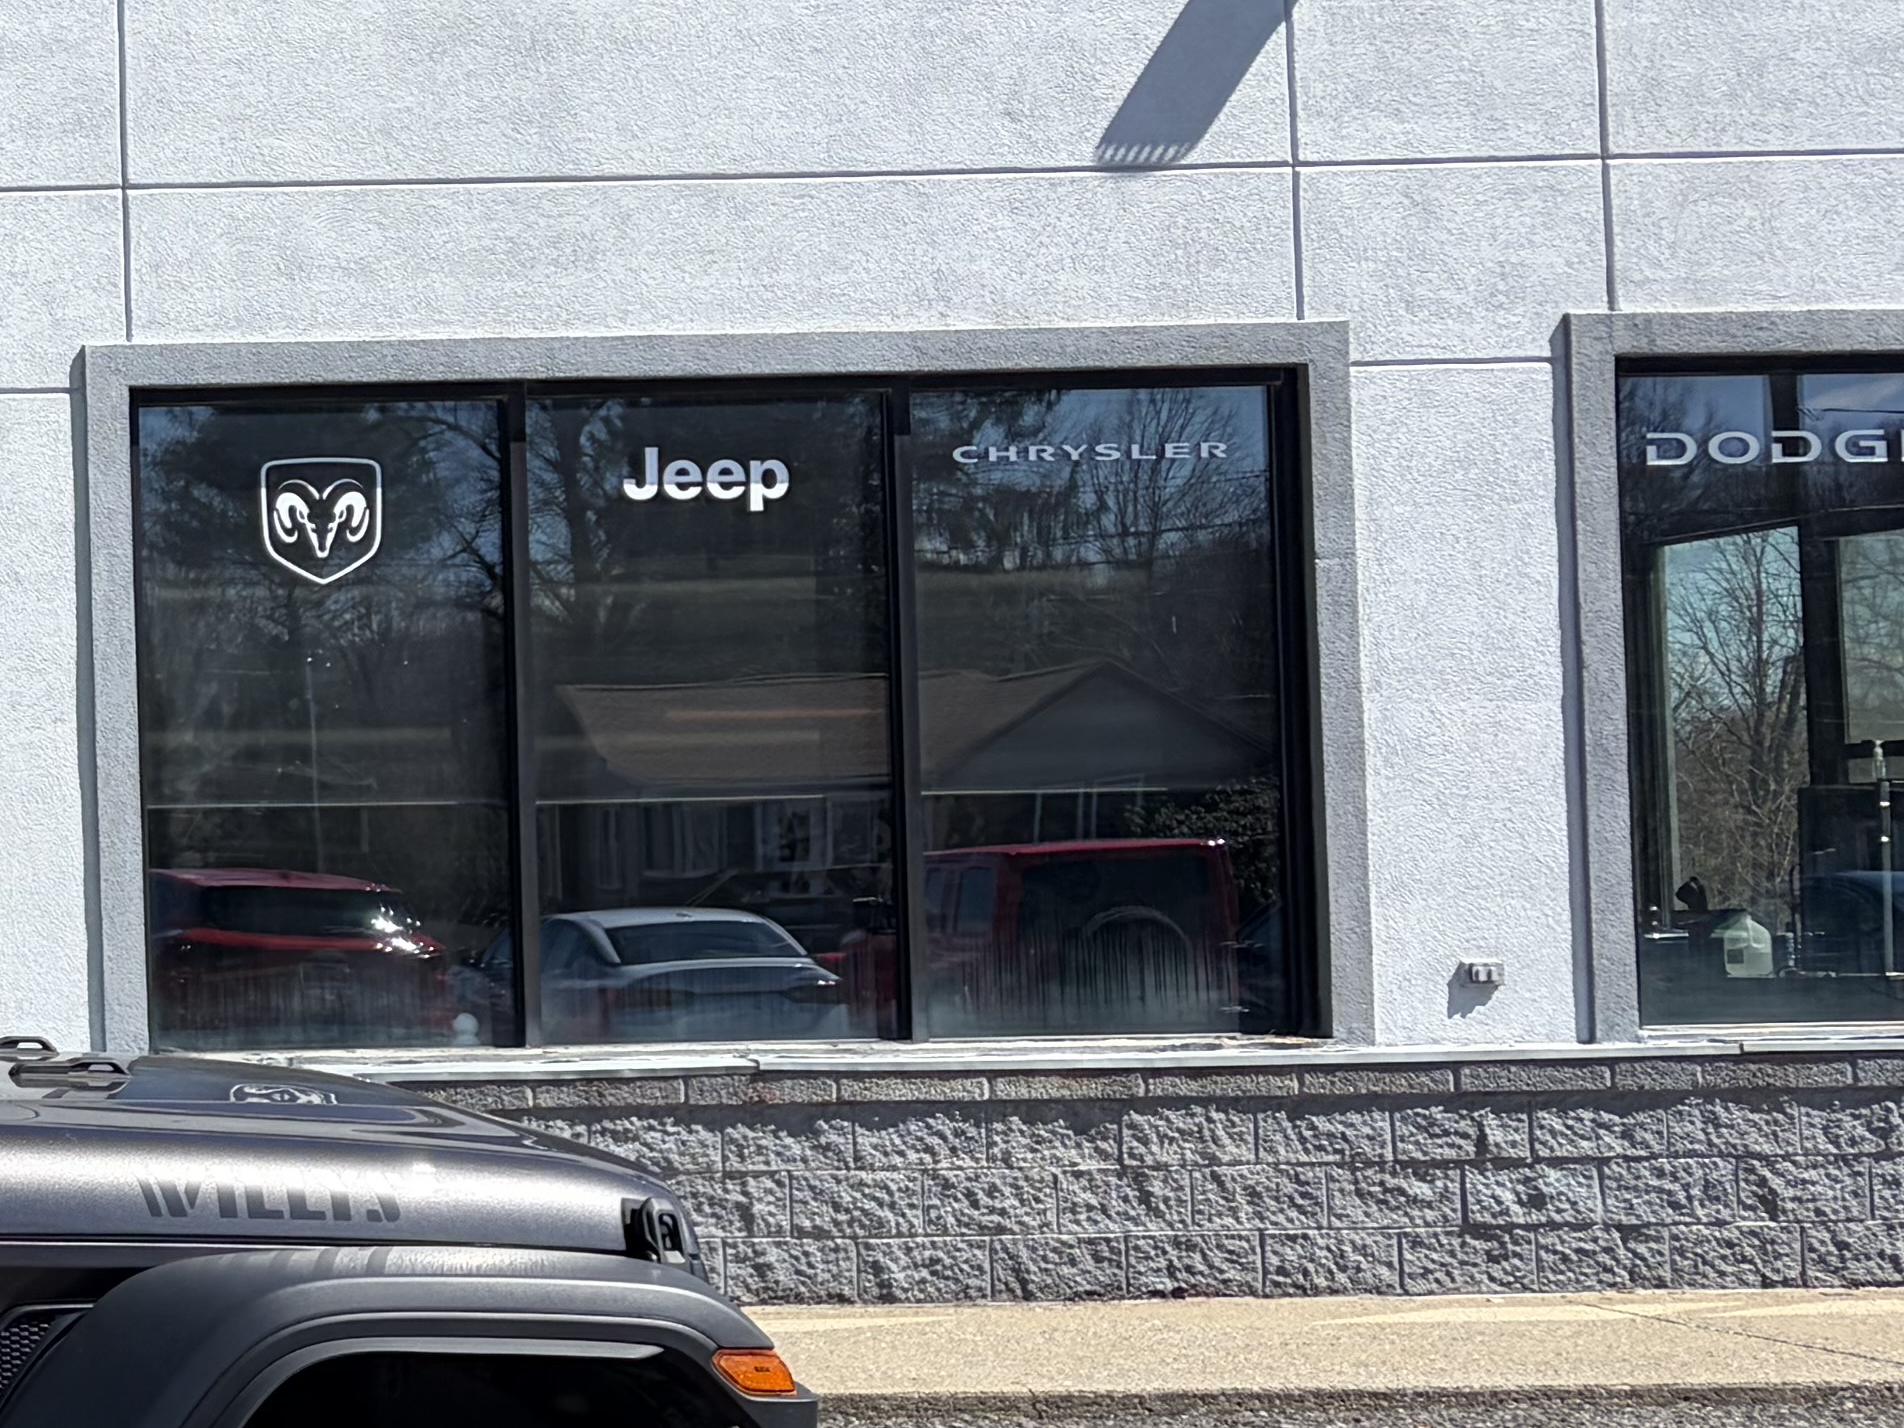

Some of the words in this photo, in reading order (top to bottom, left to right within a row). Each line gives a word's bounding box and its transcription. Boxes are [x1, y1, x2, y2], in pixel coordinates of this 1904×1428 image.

[952, 442, 1227, 464] CHRYSLER
[1646, 429, 1904, 466] DODG
[622, 446, 789, 512] Jeep
